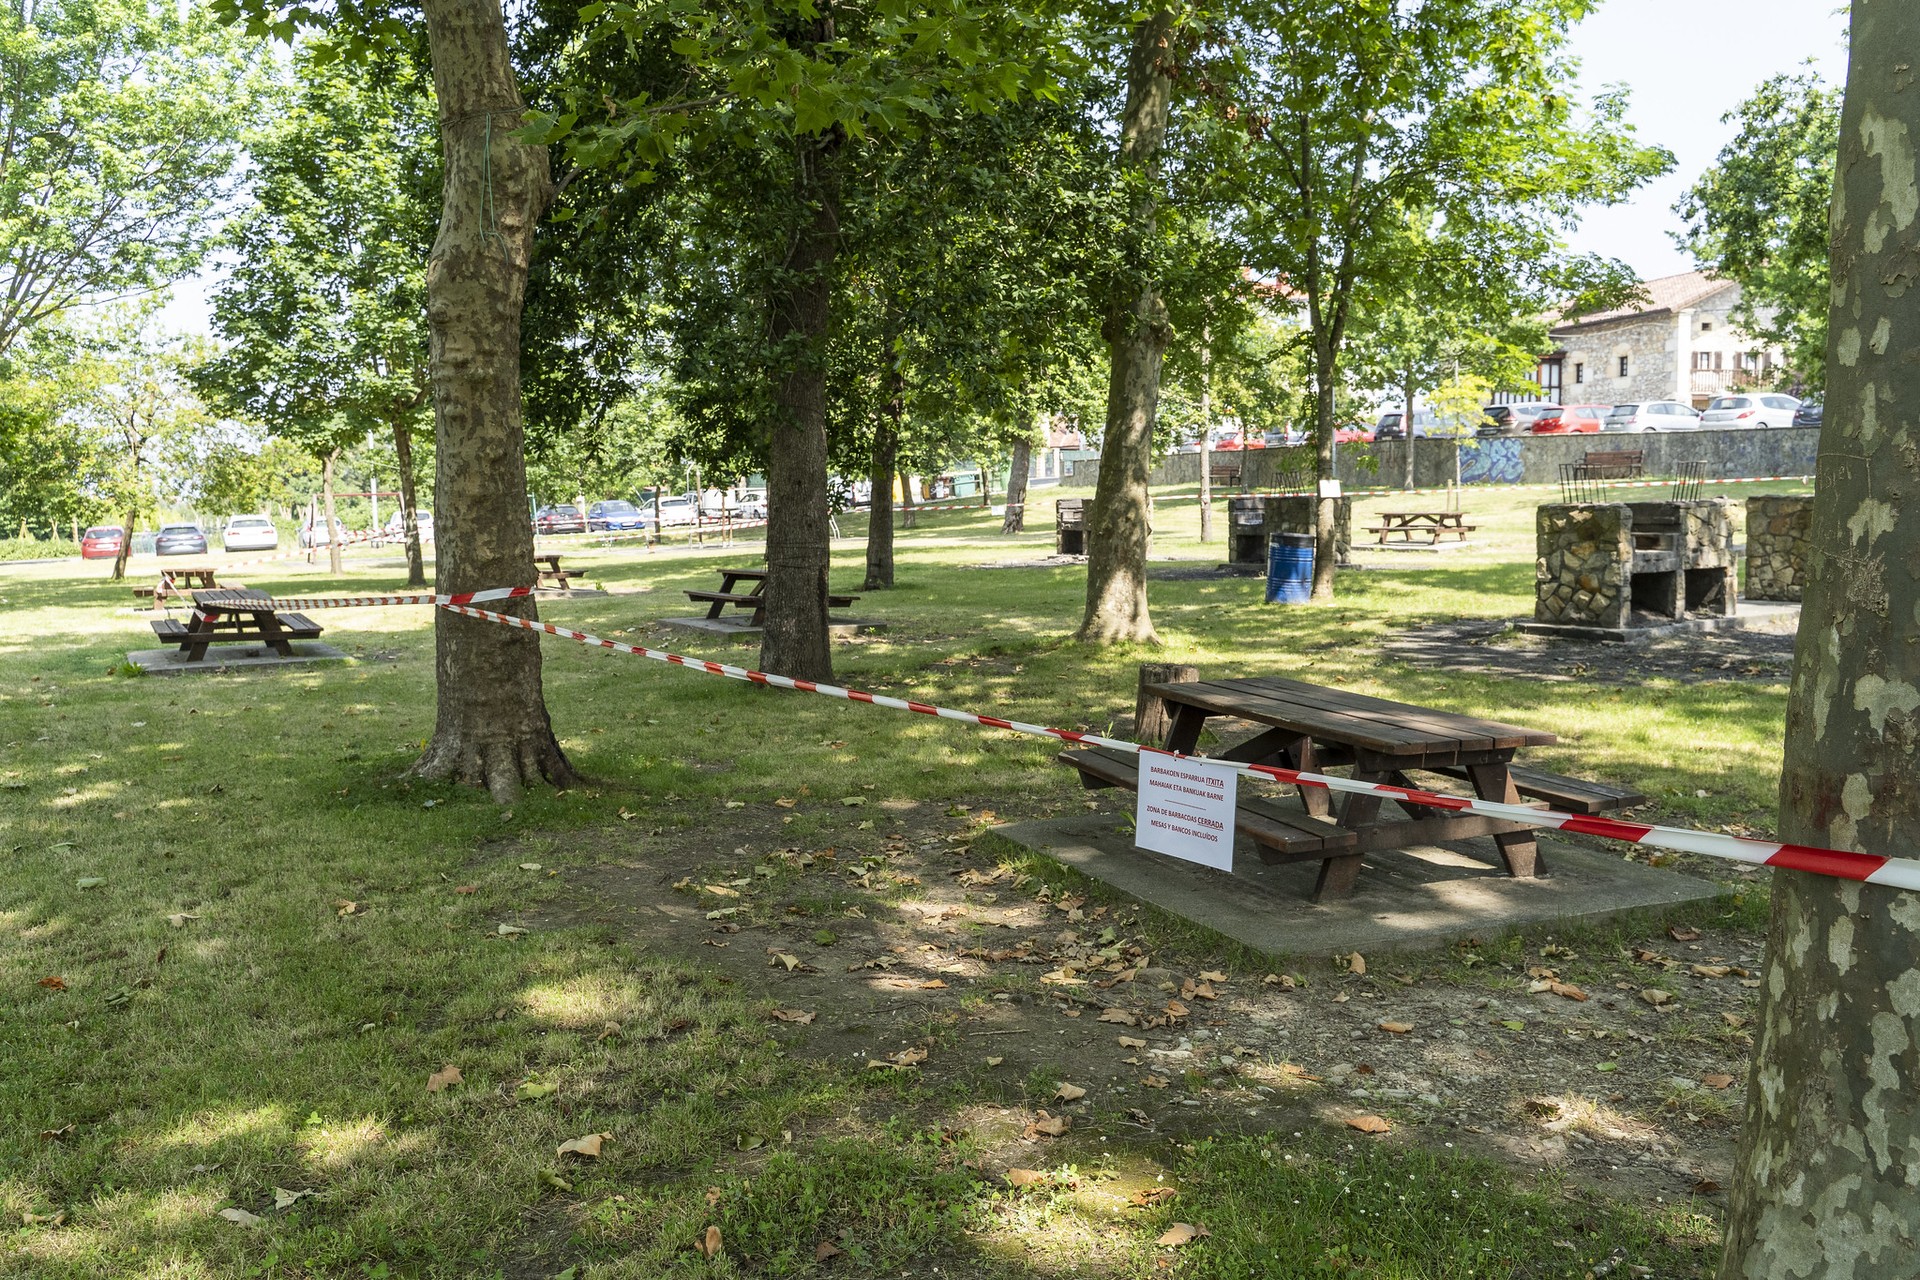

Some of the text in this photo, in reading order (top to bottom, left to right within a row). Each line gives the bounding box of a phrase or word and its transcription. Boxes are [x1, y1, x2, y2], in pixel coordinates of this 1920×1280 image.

[1150, 766, 1224, 787] BARBAKOEN ESPARRUA ITXITA
[1149, 779, 1224, 802] MAHAIAK ETA BANKUAK BARNE
[1146, 805, 1224, 829] ZONA DE BARBACOAS CERRADA
[1150, 819, 1167, 829] MESAS
[1171, 824, 1191, 835] BANCOS
